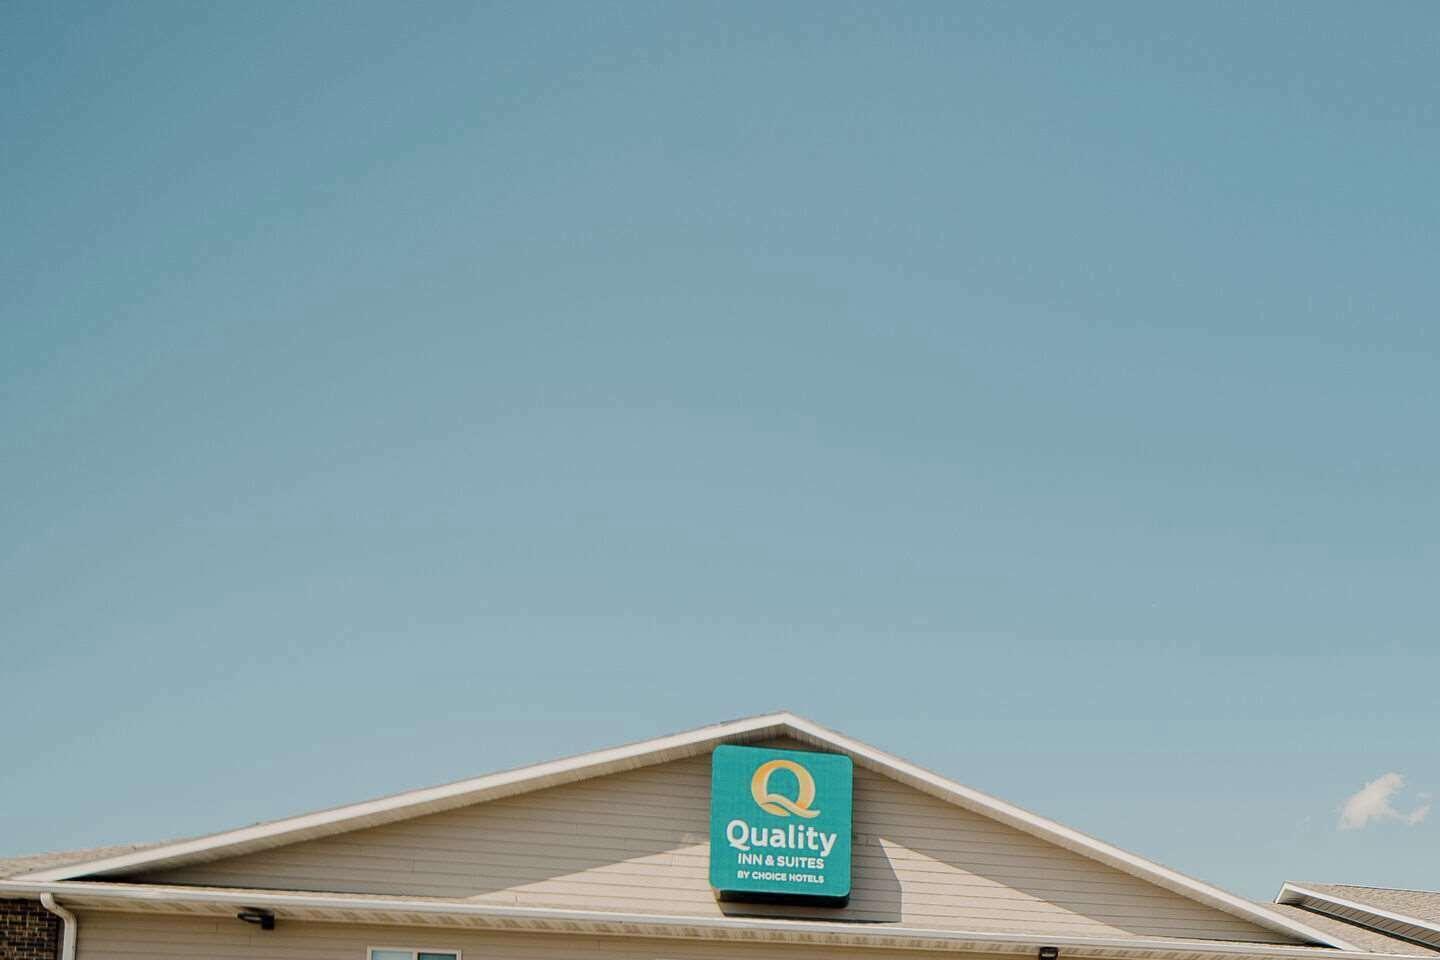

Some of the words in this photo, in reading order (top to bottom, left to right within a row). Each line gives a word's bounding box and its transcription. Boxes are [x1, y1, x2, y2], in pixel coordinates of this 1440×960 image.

[751, 759, 821, 818] Q
[726, 819, 837, 857] Quality
[738, 853, 763, 865] INN
[765, 855, 774, 865] &
[777, 857, 824, 869] SUITES
[737, 870, 749, 879] BY
[752, 871, 787, 881] CHOICE
[789, 873, 824, 884] HOTELS
